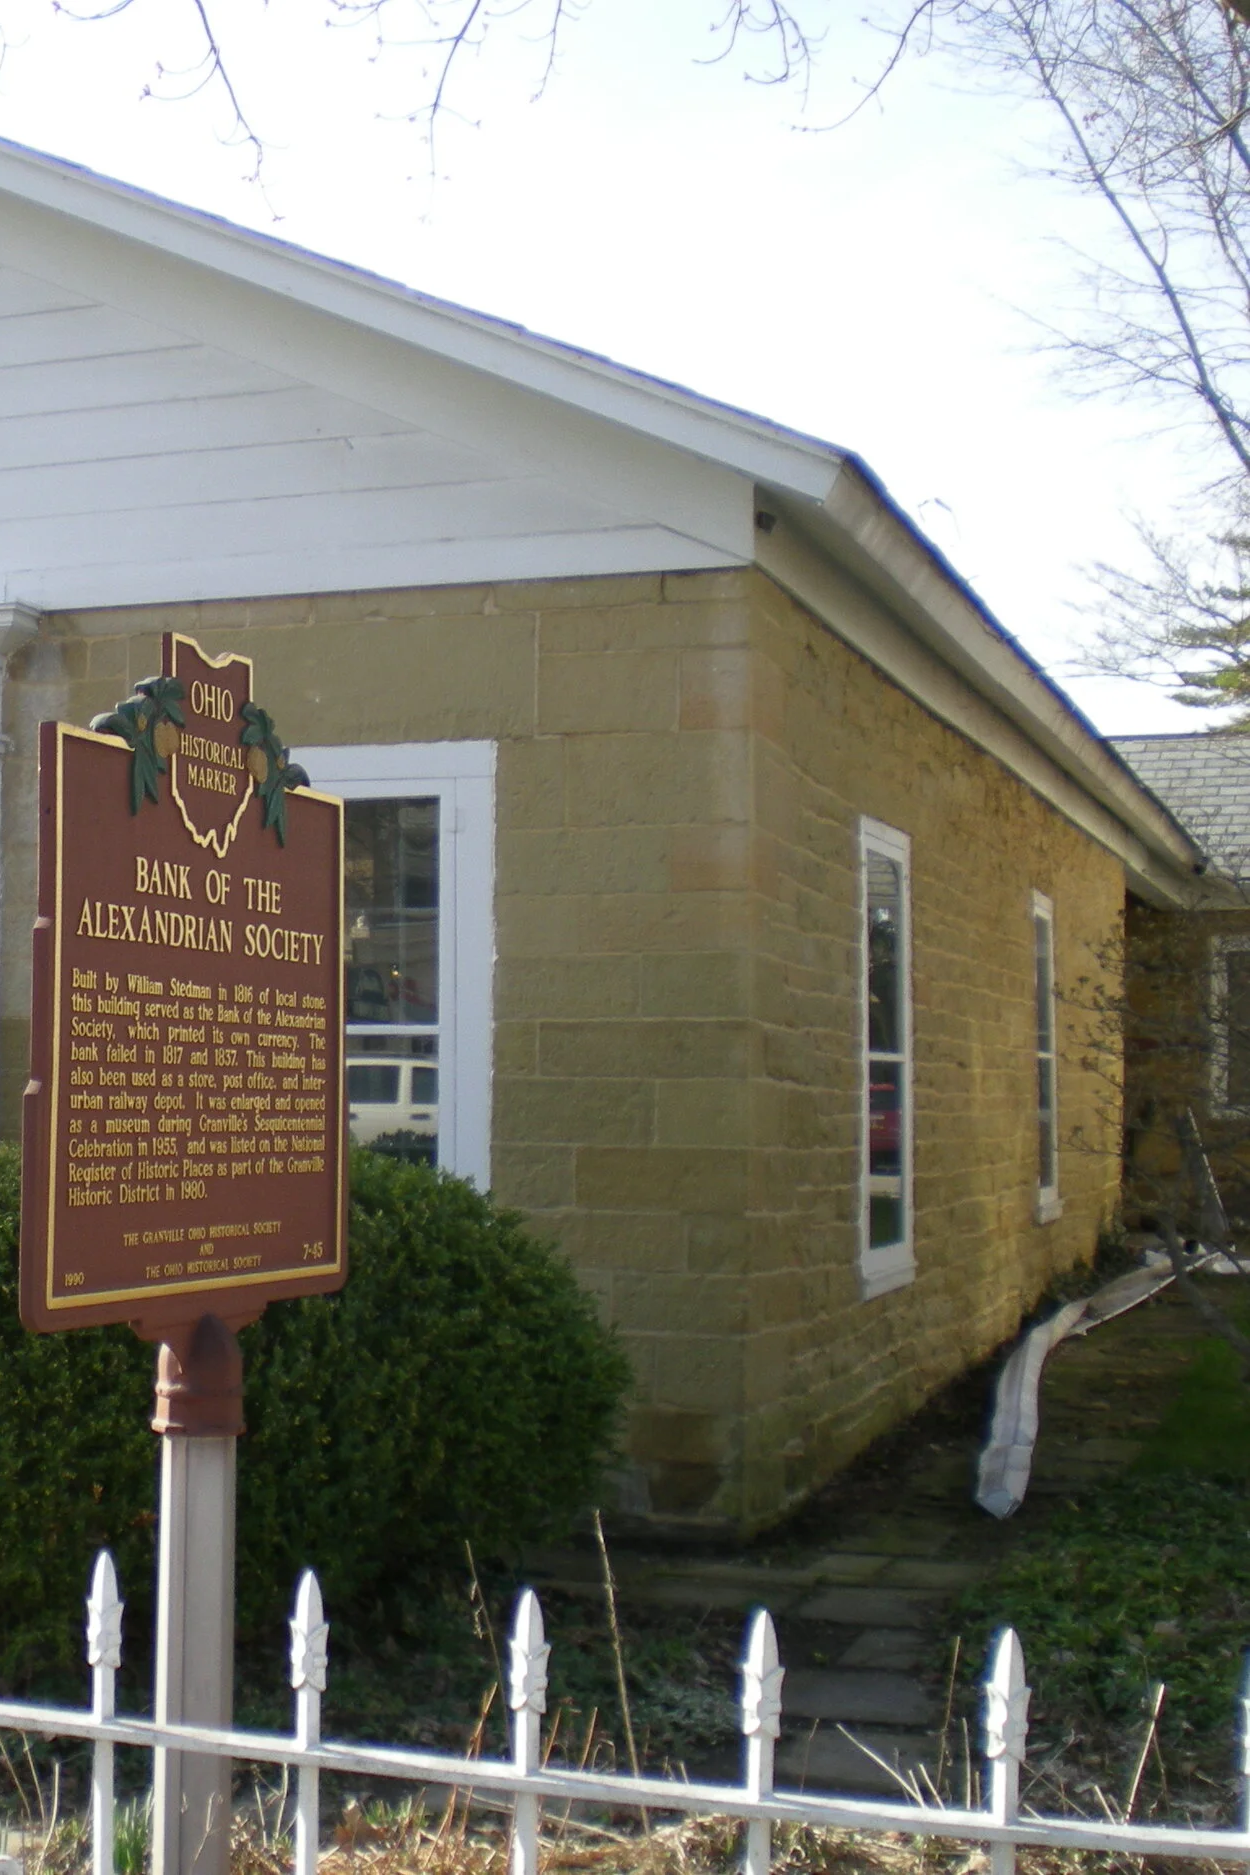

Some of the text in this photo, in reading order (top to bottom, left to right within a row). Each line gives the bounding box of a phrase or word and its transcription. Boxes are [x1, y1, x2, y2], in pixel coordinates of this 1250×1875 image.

[191, 680, 234, 722] OHIO
[180, 732, 244, 770] HISTORICAL
[188, 763, 236, 796] MARKER
[135, 856, 282, 914] BANK OF THE
[76, 897, 324, 965] ALEXANDRIAN SOCIETY
[72, 967, 97, 989] Built
[105, 972, 119, 994] by
[127, 973, 163, 995] William
[170, 978, 212, 999] Stedman
[218, 983, 227, 1001] in
[234, 984, 253, 1003] 1816
[259, 987, 270, 1005] of
[275, 989, 297, 1007] local
[72, 992, 326, 1030] this building served as the Bank of the Alexandrian
[71, 1016, 116, 1040] Society,
[128, 1021, 159, 1040] which
[168, 1025, 205, 1044] printed
[213, 1026, 224, 1044] its
[231, 1032, 250, 1045] own
[309, 1033, 326, 1050] The
[71, 1041, 98, 1061] bank
[107, 1043, 137, 1063] failed
[145, 1046, 155, 1064] in
[163, 1045, 184, 1065] 1817
[190, 1048, 208, 1066] and
[246, 1050, 266, 1067] This
[272, 1051, 305, 1073] building
[311, 1053, 326, 1070] has
[71, 1066, 93, 1085] also
[99, 1067, 126, 1086] been
[132, 1068, 156, 1087] used
[161, 1074, 173, 1087] as
[178, 1074, 183, 1087] a
[223, 1072, 243, 1092] post
[283, 1074, 298, 1090] and
[302, 1074, 326, 1090] inter-
[70, 1090, 326, 1114] urban railway depot. It was enlarged and opened
[70, 1113, 326, 1136] as a museum during Granville's Sesquicentennial
[69, 1134, 325, 1158] Celebration in 1955, and was listed on the National
[69, 1156, 325, 1187] Register of Historic Places as part of the Granville
[69, 1180, 208, 1207] Historic District in 1980.
[123, 1221, 282, 1246] THE GRANVILLE OHIO HISTORICAL SOCIETY
[200, 1243, 214, 1256] AND
[302, 1241, 323, 1259] 7-45
[65, 1272, 85, 1286] 1990
[146, 1255, 262, 1279] THE OHIO HISTORICAL SOCIETY
